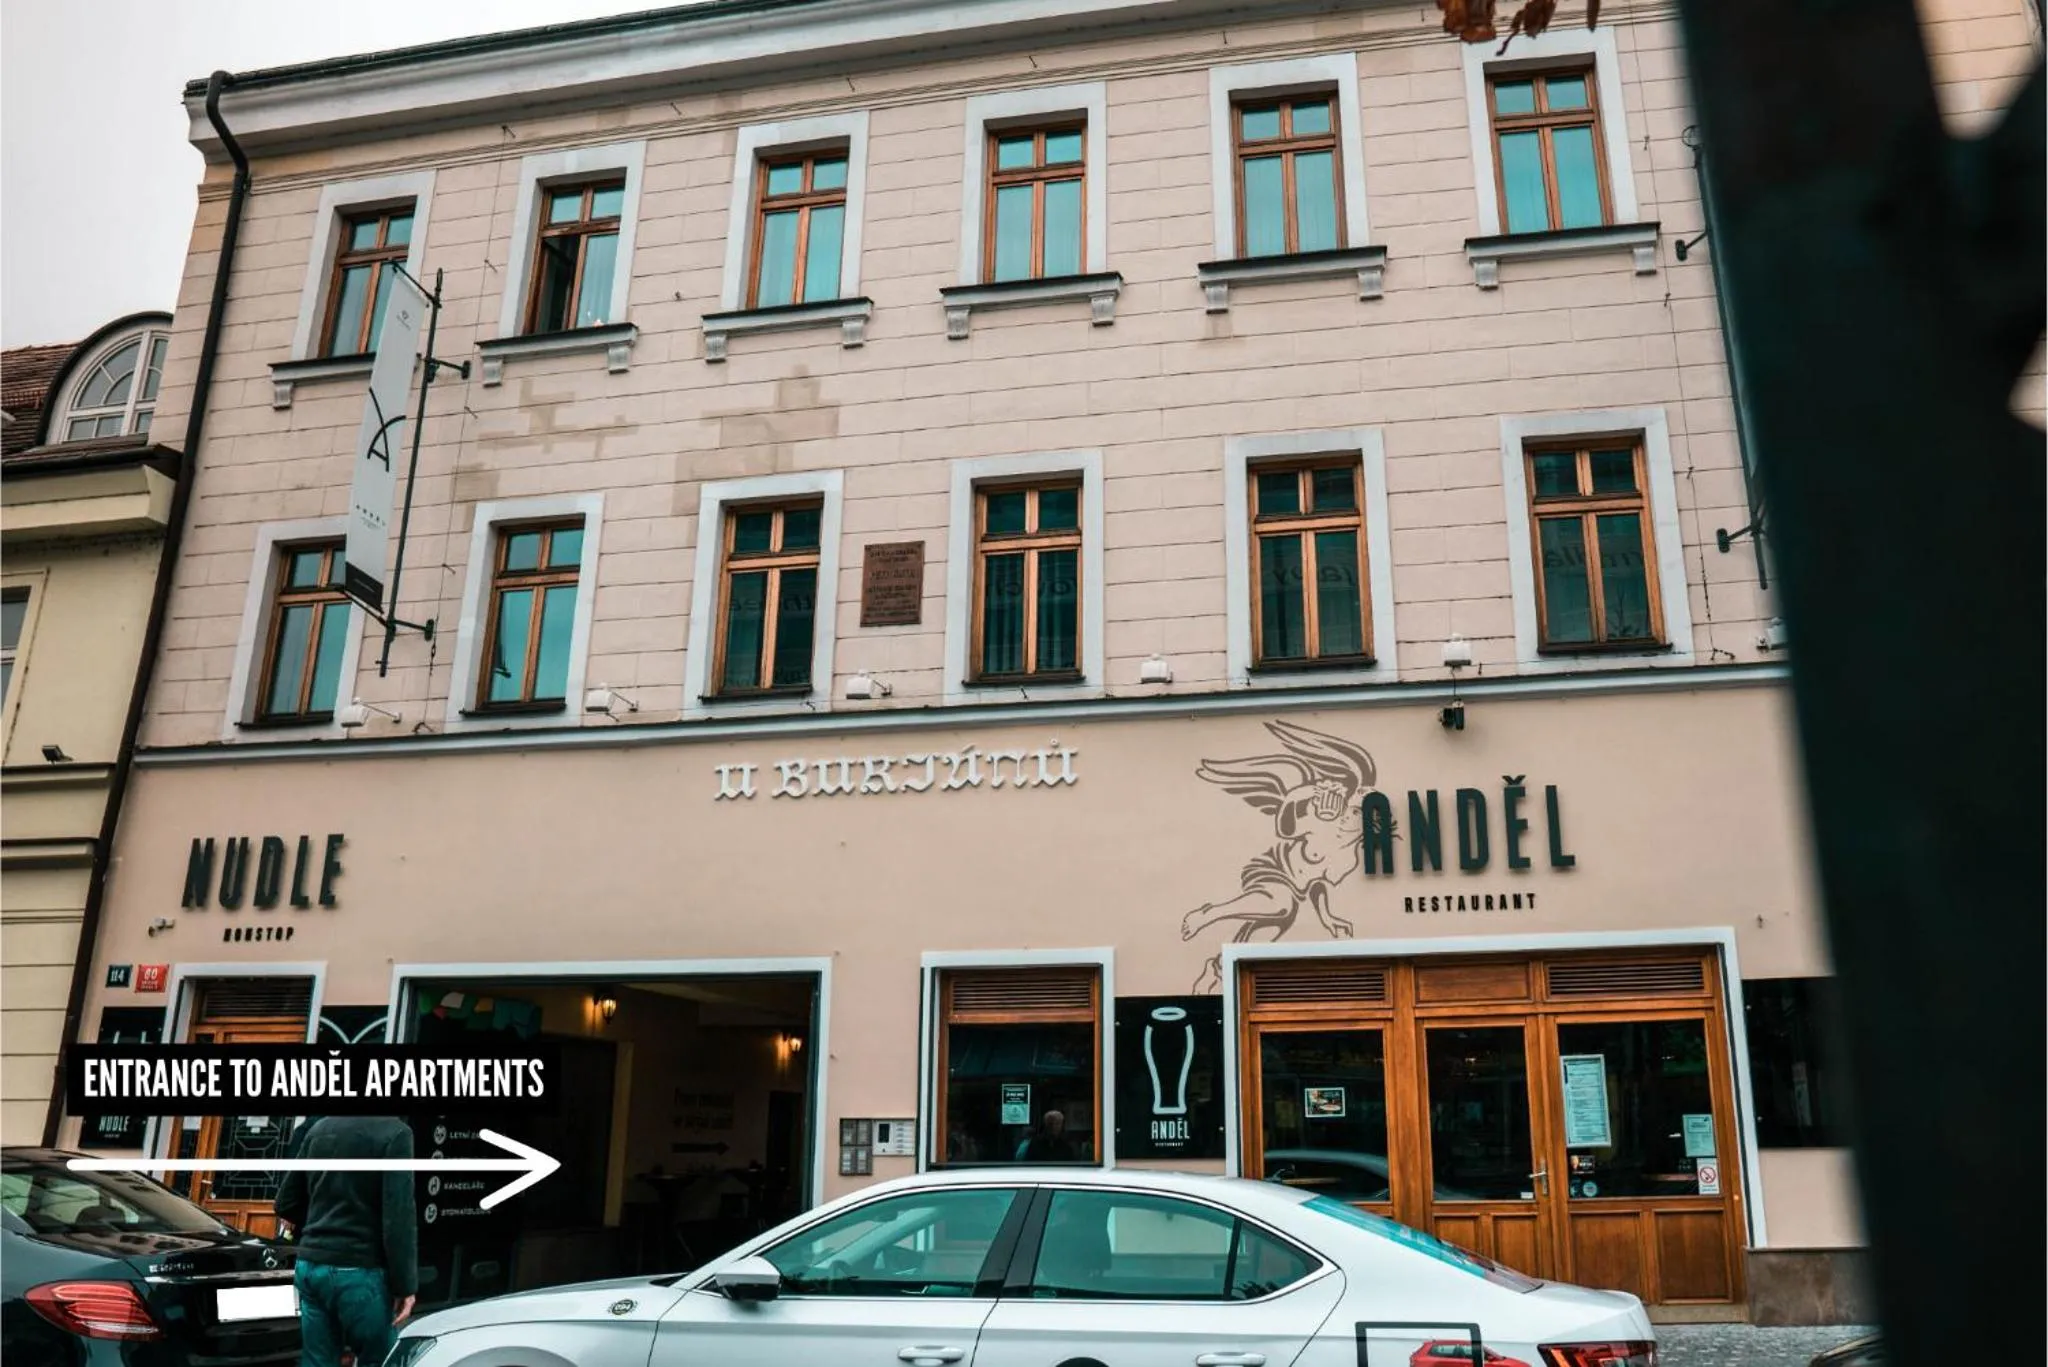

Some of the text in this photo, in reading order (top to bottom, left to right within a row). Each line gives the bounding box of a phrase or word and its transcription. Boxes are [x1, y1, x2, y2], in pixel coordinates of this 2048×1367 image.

[1361, 775, 1576, 874] ANDĚL
[181, 833, 345, 908] NUDLE
[1404, 893, 1536, 913] RESTAURANT
[223, 927, 294, 942] NONSTOP
[1151, 1117, 1190, 1140] ANDĚL
